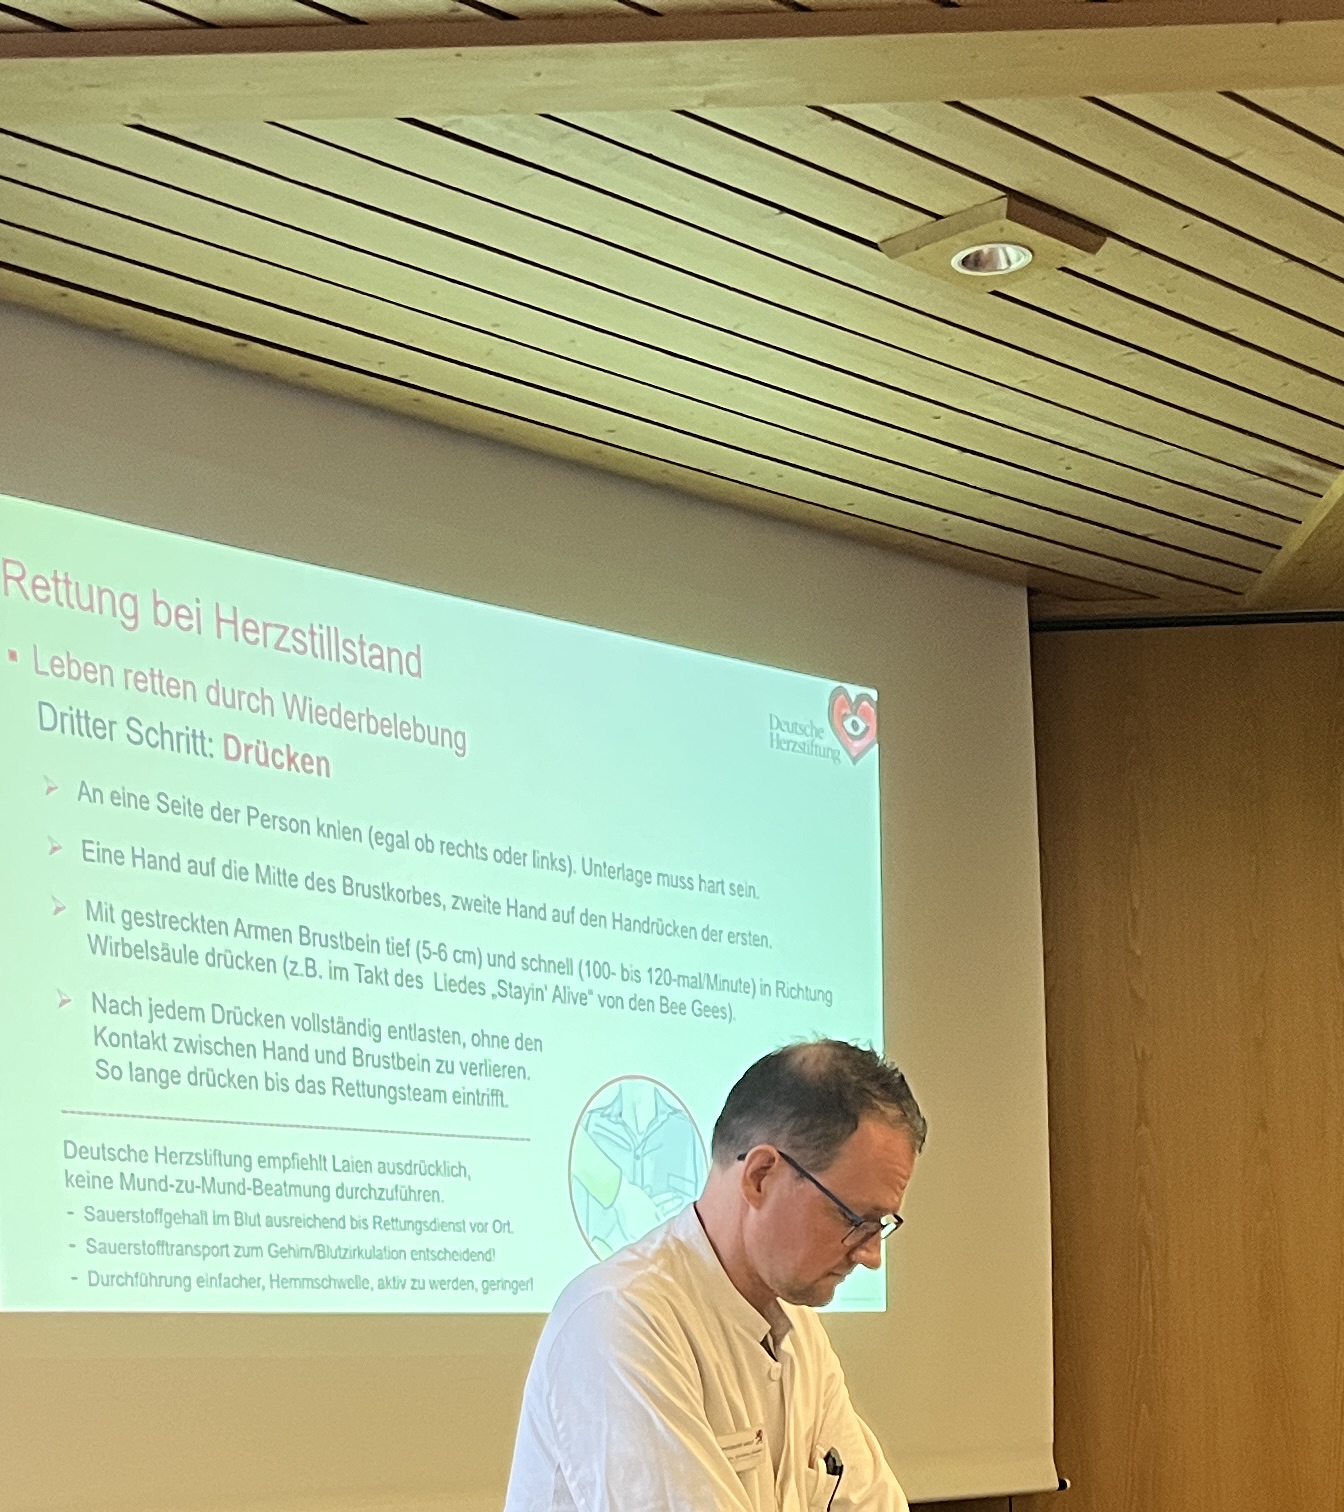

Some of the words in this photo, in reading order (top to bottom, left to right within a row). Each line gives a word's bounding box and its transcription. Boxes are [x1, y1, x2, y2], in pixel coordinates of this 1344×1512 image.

[2, 557, 138, 632] Rettung
[153, 588, 202, 636] bei
[215, 601, 422, 679] Herzstillstand
[33, 643, 114, 688] Leben
[124, 667, 197, 703] retten
[206, 678, 274, 718] durch
[283, 691, 466, 758] Wiederbelebung
[769, 713, 825, 740] Deutsche
[38, 700, 116, 742] Dritter
[126, 715, 213, 759] Schritt:
[224, 732, 331, 779] Drücken
[769, 731, 841, 765] Herzstiftung
[76, 779, 105, 805] An
[109, 785, 151, 812] eine
[156, 791, 204, 820] Seite
[210, 800, 241, 825] der
[246, 804, 311, 837] Person
[316, 816, 363, 844] knien
[367, 824, 410, 854] (egal
[414, 832, 435, 854] ob
[439, 838, 489, 862] rechts
[492, 845, 528, 868] oder
[532, 849, 578, 878] links).
[581, 856, 653, 889] Unterlage
[656, 872, 695, 891] muss
[697, 873, 725, 896] hart
[728, 882, 761, 899] sein.
[81, 838, 126, 867] Eine
[130, 845, 182, 874] Hand
[186, 856, 217, 878] auf
[221, 858, 250, 883] die
[254, 862, 299, 890] Mitte
[303, 870, 337, 895] des
[341, 874, 447, 912] Brustkorbes,
[451, 894, 502, 916] zweite
[505, 897, 547, 922] Hand
[551, 905, 577, 925] auf
[579, 907, 608, 929] den
[611, 911, 698, 941] Handrücken
[700, 923, 724, 943] der
[726, 930, 773, 949] ersten.
[85, 898, 116, 925] Mit
[121, 908, 229, 937] gestreckten
[233, 917, 293, 945] Armen
[298, 924, 381, 955] Brustbein
[385, 937, 413, 958] tief
[415, 939, 448, 965] (5-6
[451, 946, 483, 971] cm)
[487, 950, 517, 970] und
[520, 953, 574, 977] schnell
[577, 958, 617, 982] (100-
[620, 962, 642, 984] bis
[759, 978, 772, 997] in
[774, 979, 833, 1008] Richtung
[86, 932, 200, 967] Wirbelsäule
[204, 946, 277, 975] drücken
[282, 954, 323, 981] (z.B.
[328, 959, 350, 983] im
[353, 962, 389, 987] Takt
[394, 967, 424, 990] des
[432, 971, 487, 997] Liedes
[597, 993, 625, 1010] von
[628, 993, 655, 1013] den
[659, 994, 687, 1017] Bee
[90, 991, 143, 1018] Nach
[147, 996, 206, 1025] jedem
[210, 1002, 286, 1030] Drücken
[290, 1011, 382, 1044] vollständig
[387, 1022, 467, 1050] entlasten,
[470, 1028, 510, 1051] ohne
[513, 1032, 543, 1053] den
[92, 1024, 169, 1053] Kontakt
[172, 1033, 257, 1060] zwischen
[261, 1039, 310, 1064] Hand
[314, 1045, 347, 1067] und
[351, 1046, 431, 1074] Brustbein
[434, 1058, 455, 1075] zu
[459, 1058, 532, 1081] verlieren.
[94, 1057, 124, 1082] So
[128, 1060, 182, 1090] lange
[186, 1065, 259, 1091] drücken
[263, 1070, 290, 1094] bis
[294, 1073, 327, 1096] das
[330, 1075, 448, 1106] Rettungsteam
[451, 1086, 509, 1109] eintrifft.
[62, 1139, 150, 1164] Deutsche
[153, 1145, 253, 1173] Herzstiftung
[256, 1151, 328, 1174] empfiehlt
[331, 1154, 374, 1174] Laien
[377, 1159, 472, 1182] ausdrücklich,
[63, 1168, 114, 1191] keine
[118, 1171, 331, 1203] Mund-zu-Mund-Beatmung
[334, 1181, 444, 1204] durchzuführen.
[83, 1205, 209, 1230] Sauerstoffgehalt
[212, 1209, 231, 1226] im
[233, 1210, 262, 1228] Blut
[264, 1213, 347, 1230] ausreichend
[349, 1214, 369, 1231] bis
[371, 1214, 467, 1236] Rettungsdienst
[469, 1221, 489, 1234] vor
[85, 1237, 230, 1262] Sauerstofftransport
[232, 1244, 264, 1259] zum
[87, 1269, 192, 1293] Durchführung
[195, 1272, 266, 1291] einfacher,
[268, 1273, 375, 1292] Hemmschwelle,
[376, 1275, 407, 1291] aktiv
[409, 1277, 426, 1291] zu
[428, 1276, 479, 1293] werden,
